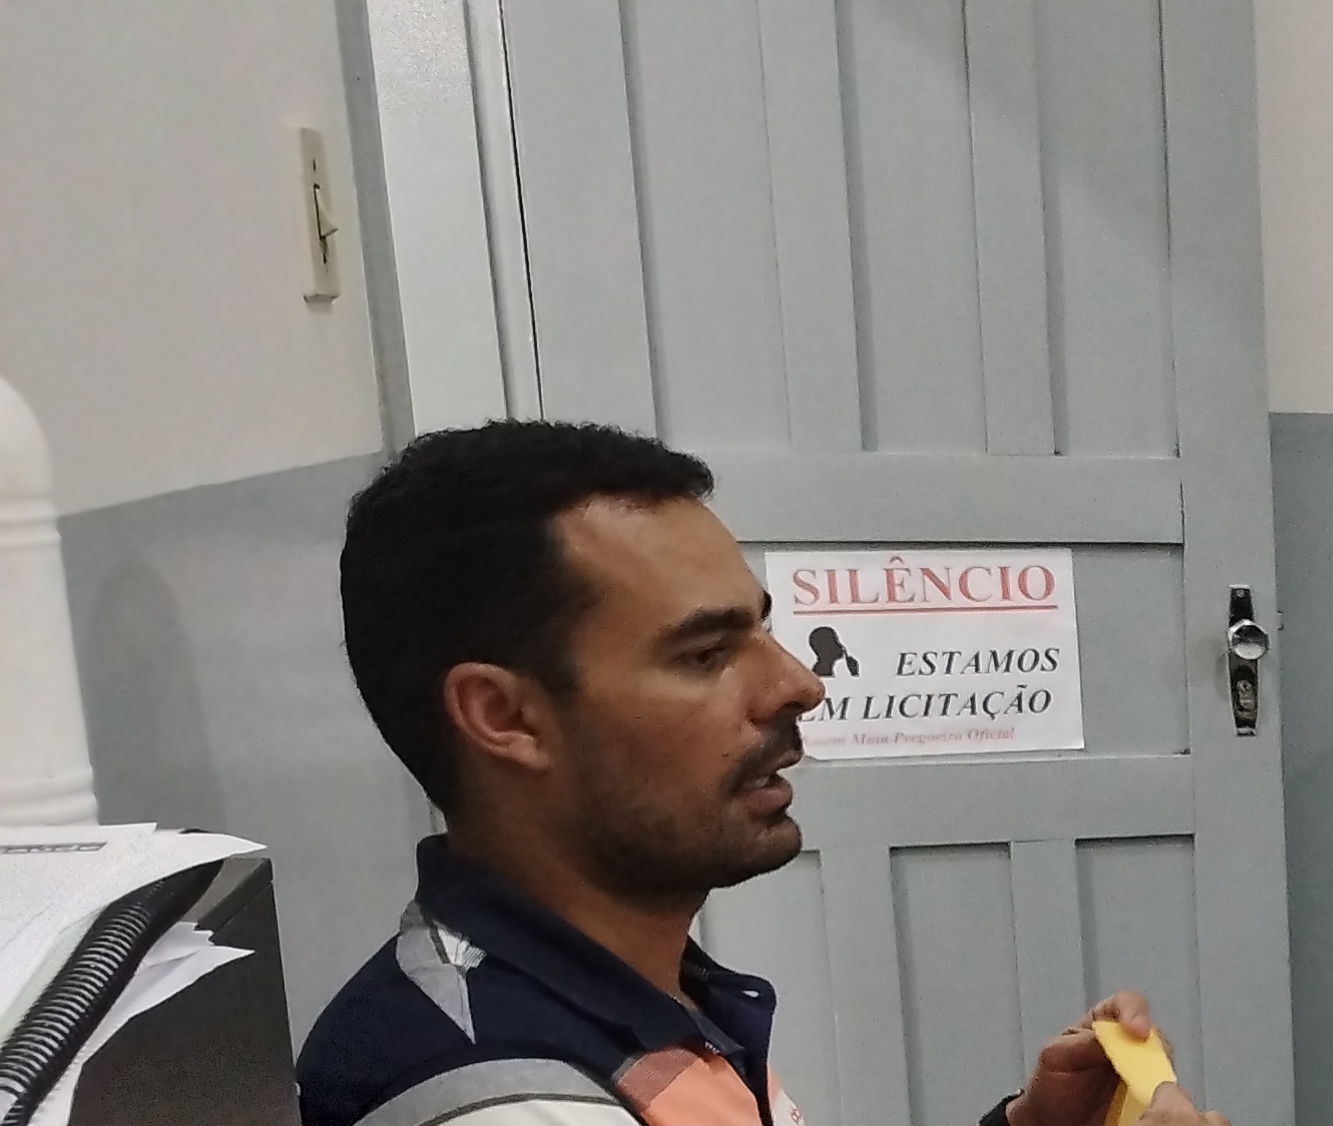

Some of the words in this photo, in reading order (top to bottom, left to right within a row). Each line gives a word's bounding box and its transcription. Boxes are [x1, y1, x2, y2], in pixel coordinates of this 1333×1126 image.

[792, 556, 1056, 605] SILÊNCIO
[895, 648, 1061, 677] ESTAMOS
[862, 685, 1052, 722] LICITAÇÃO
